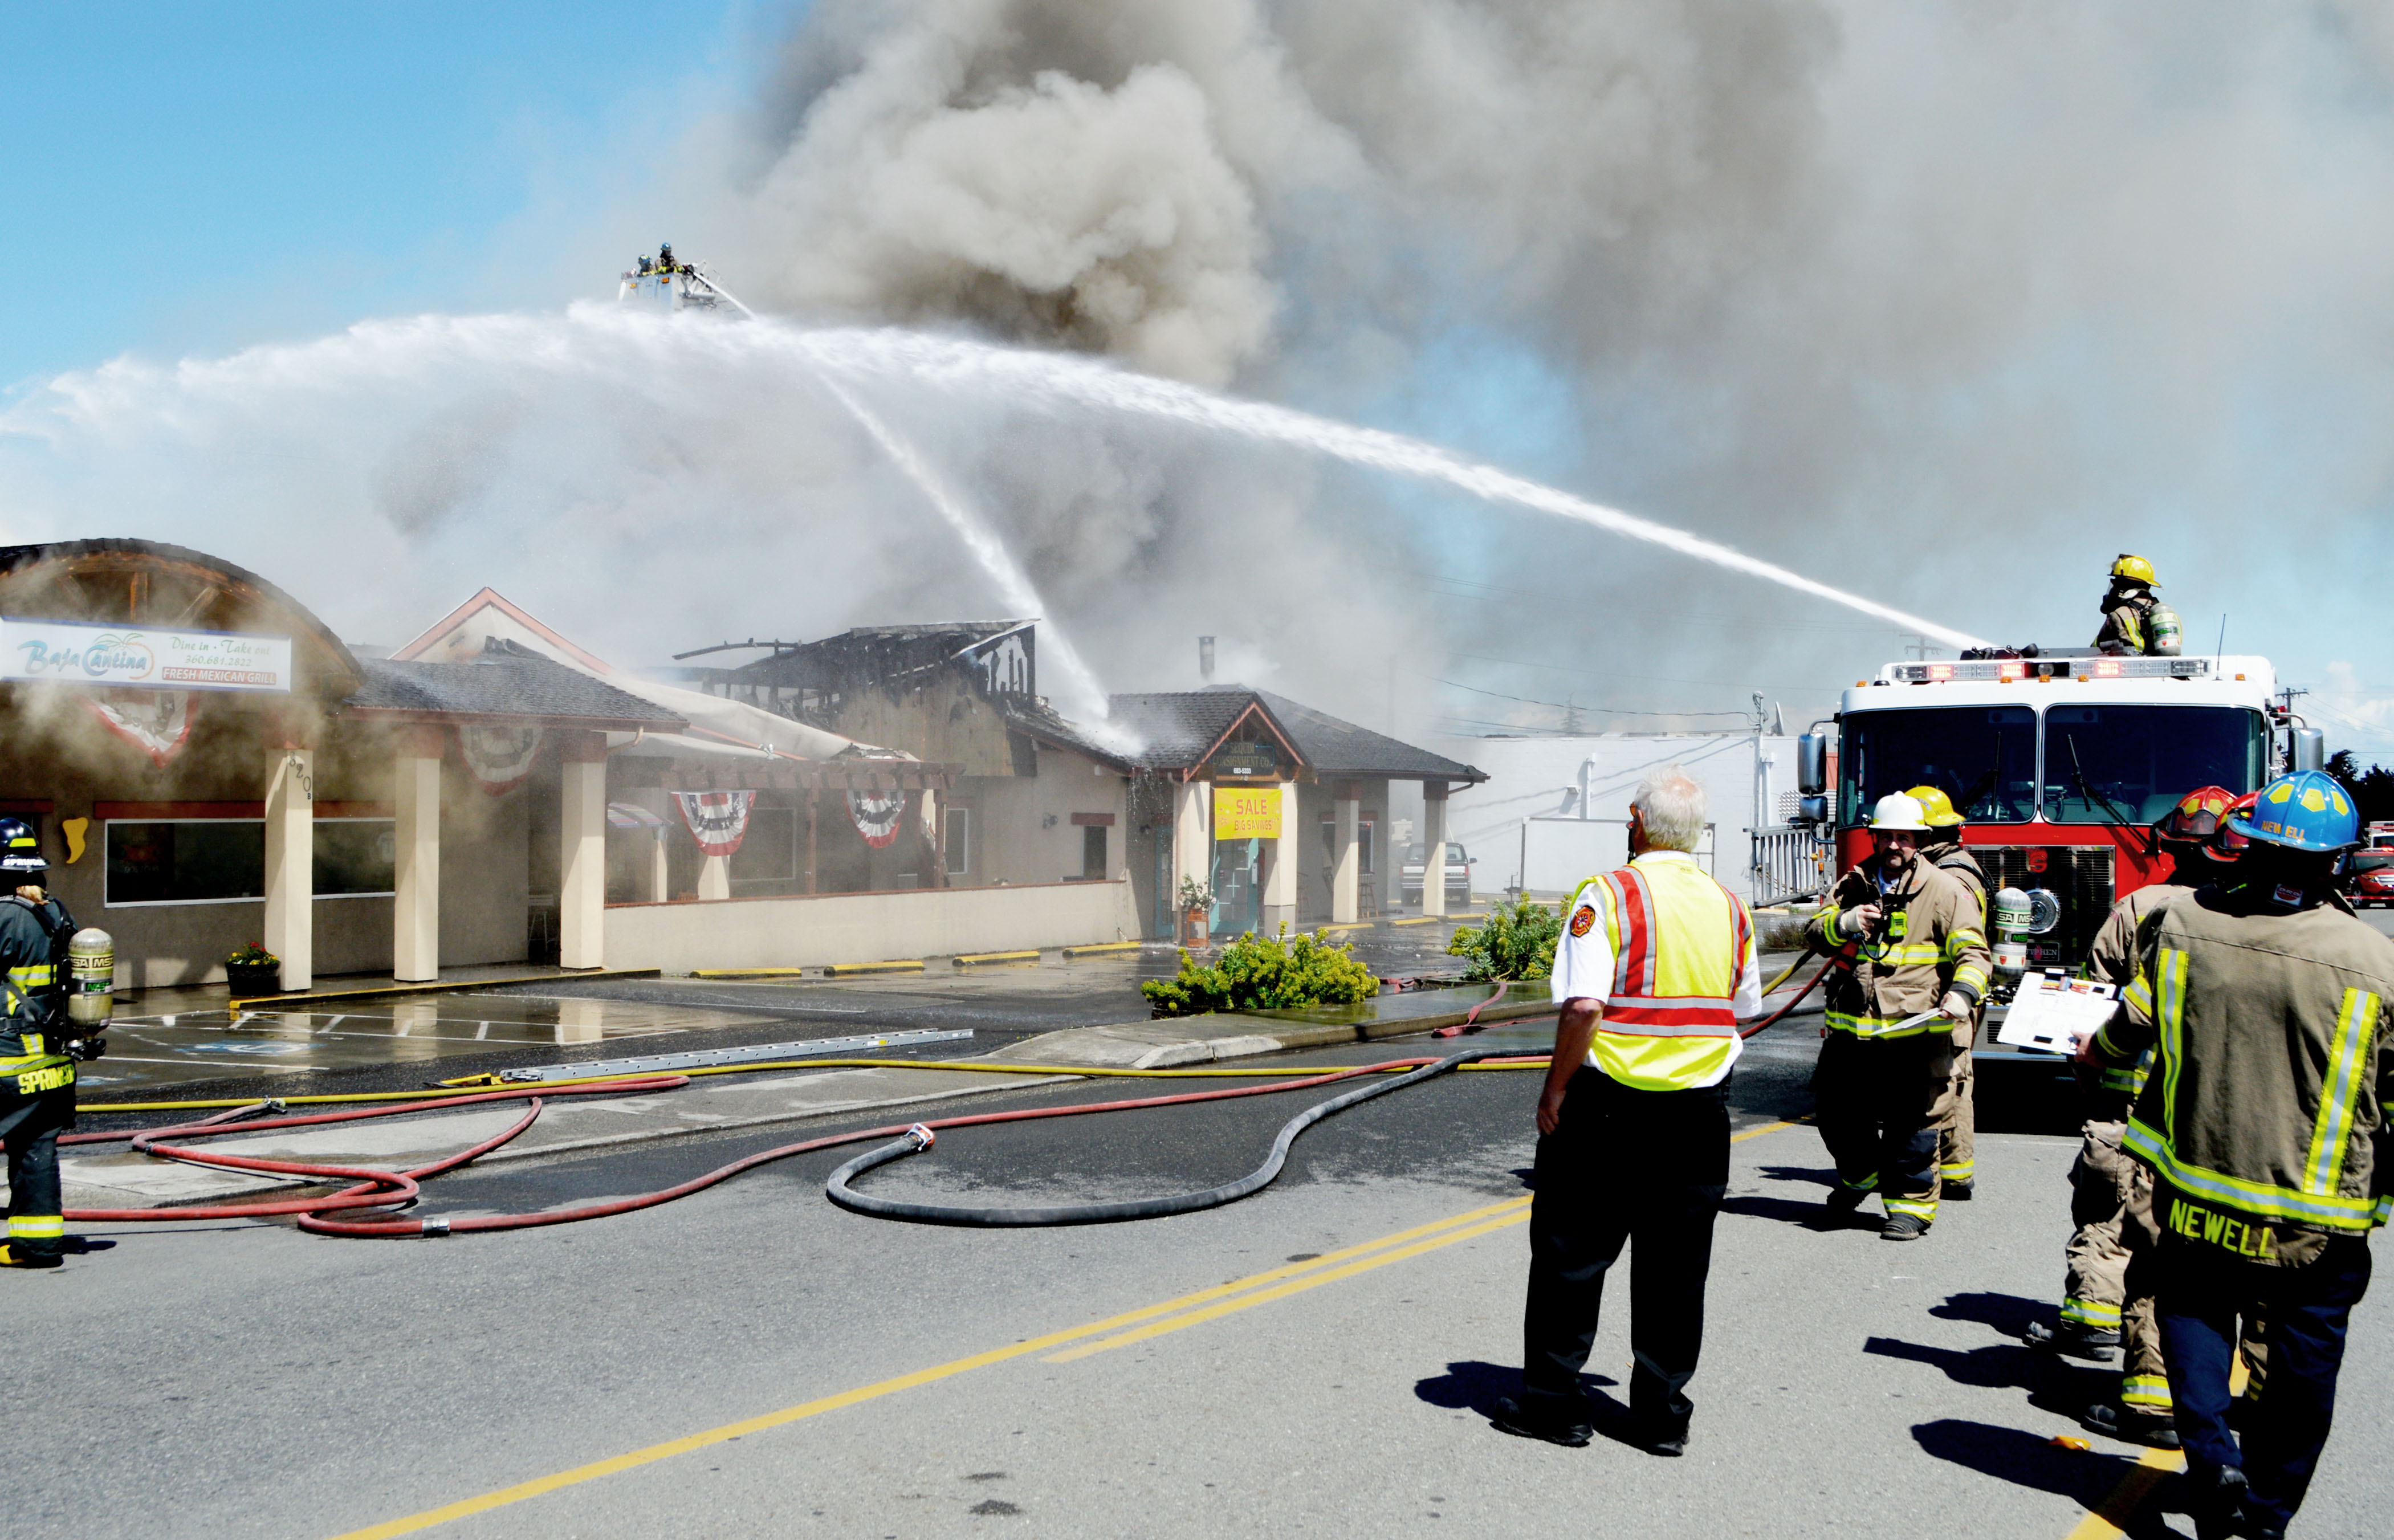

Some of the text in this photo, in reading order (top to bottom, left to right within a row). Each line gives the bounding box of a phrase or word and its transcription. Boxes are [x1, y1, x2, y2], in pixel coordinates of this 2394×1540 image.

[171, 637, 196, 650] Dine
[199, 642, 209, 651] in
[221, 639, 251, 654] Take
[17, 640, 147, 677] Baja Cantina
[163, 668, 276, 683] FRESH MEXICAN GRILL
[1212, 756, 1259, 767] CONSIGNMENT
[1236, 799, 1267, 815] SALE
[1234, 820, 1272, 830] BIG SAVINGS
[2169, 1197, 2276, 1260] NEWELL
